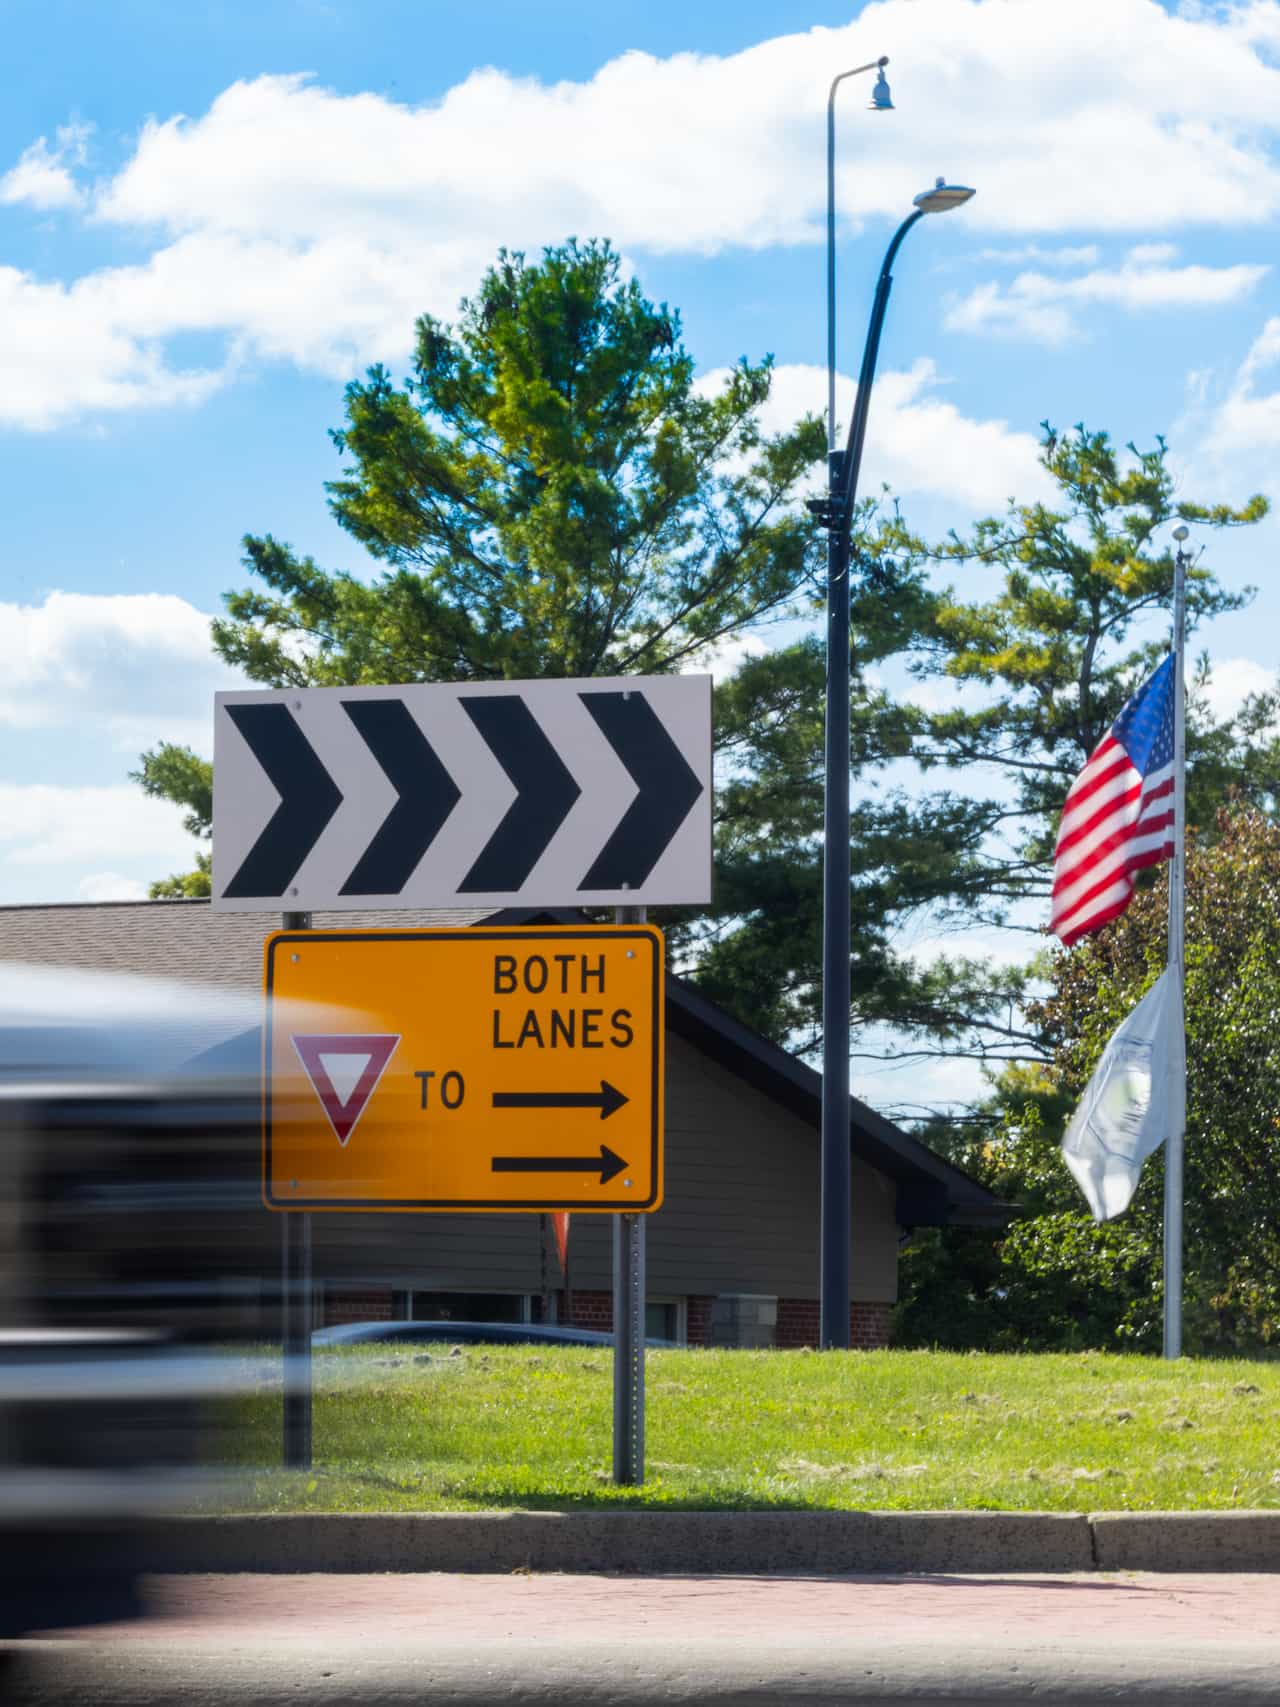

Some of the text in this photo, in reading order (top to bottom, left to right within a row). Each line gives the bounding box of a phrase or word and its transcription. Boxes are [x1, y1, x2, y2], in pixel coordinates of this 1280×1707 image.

[493, 954, 606, 995] BOTH
[492, 1008, 634, 1049] LANES
[414, 1070, 465, 1110] TO
